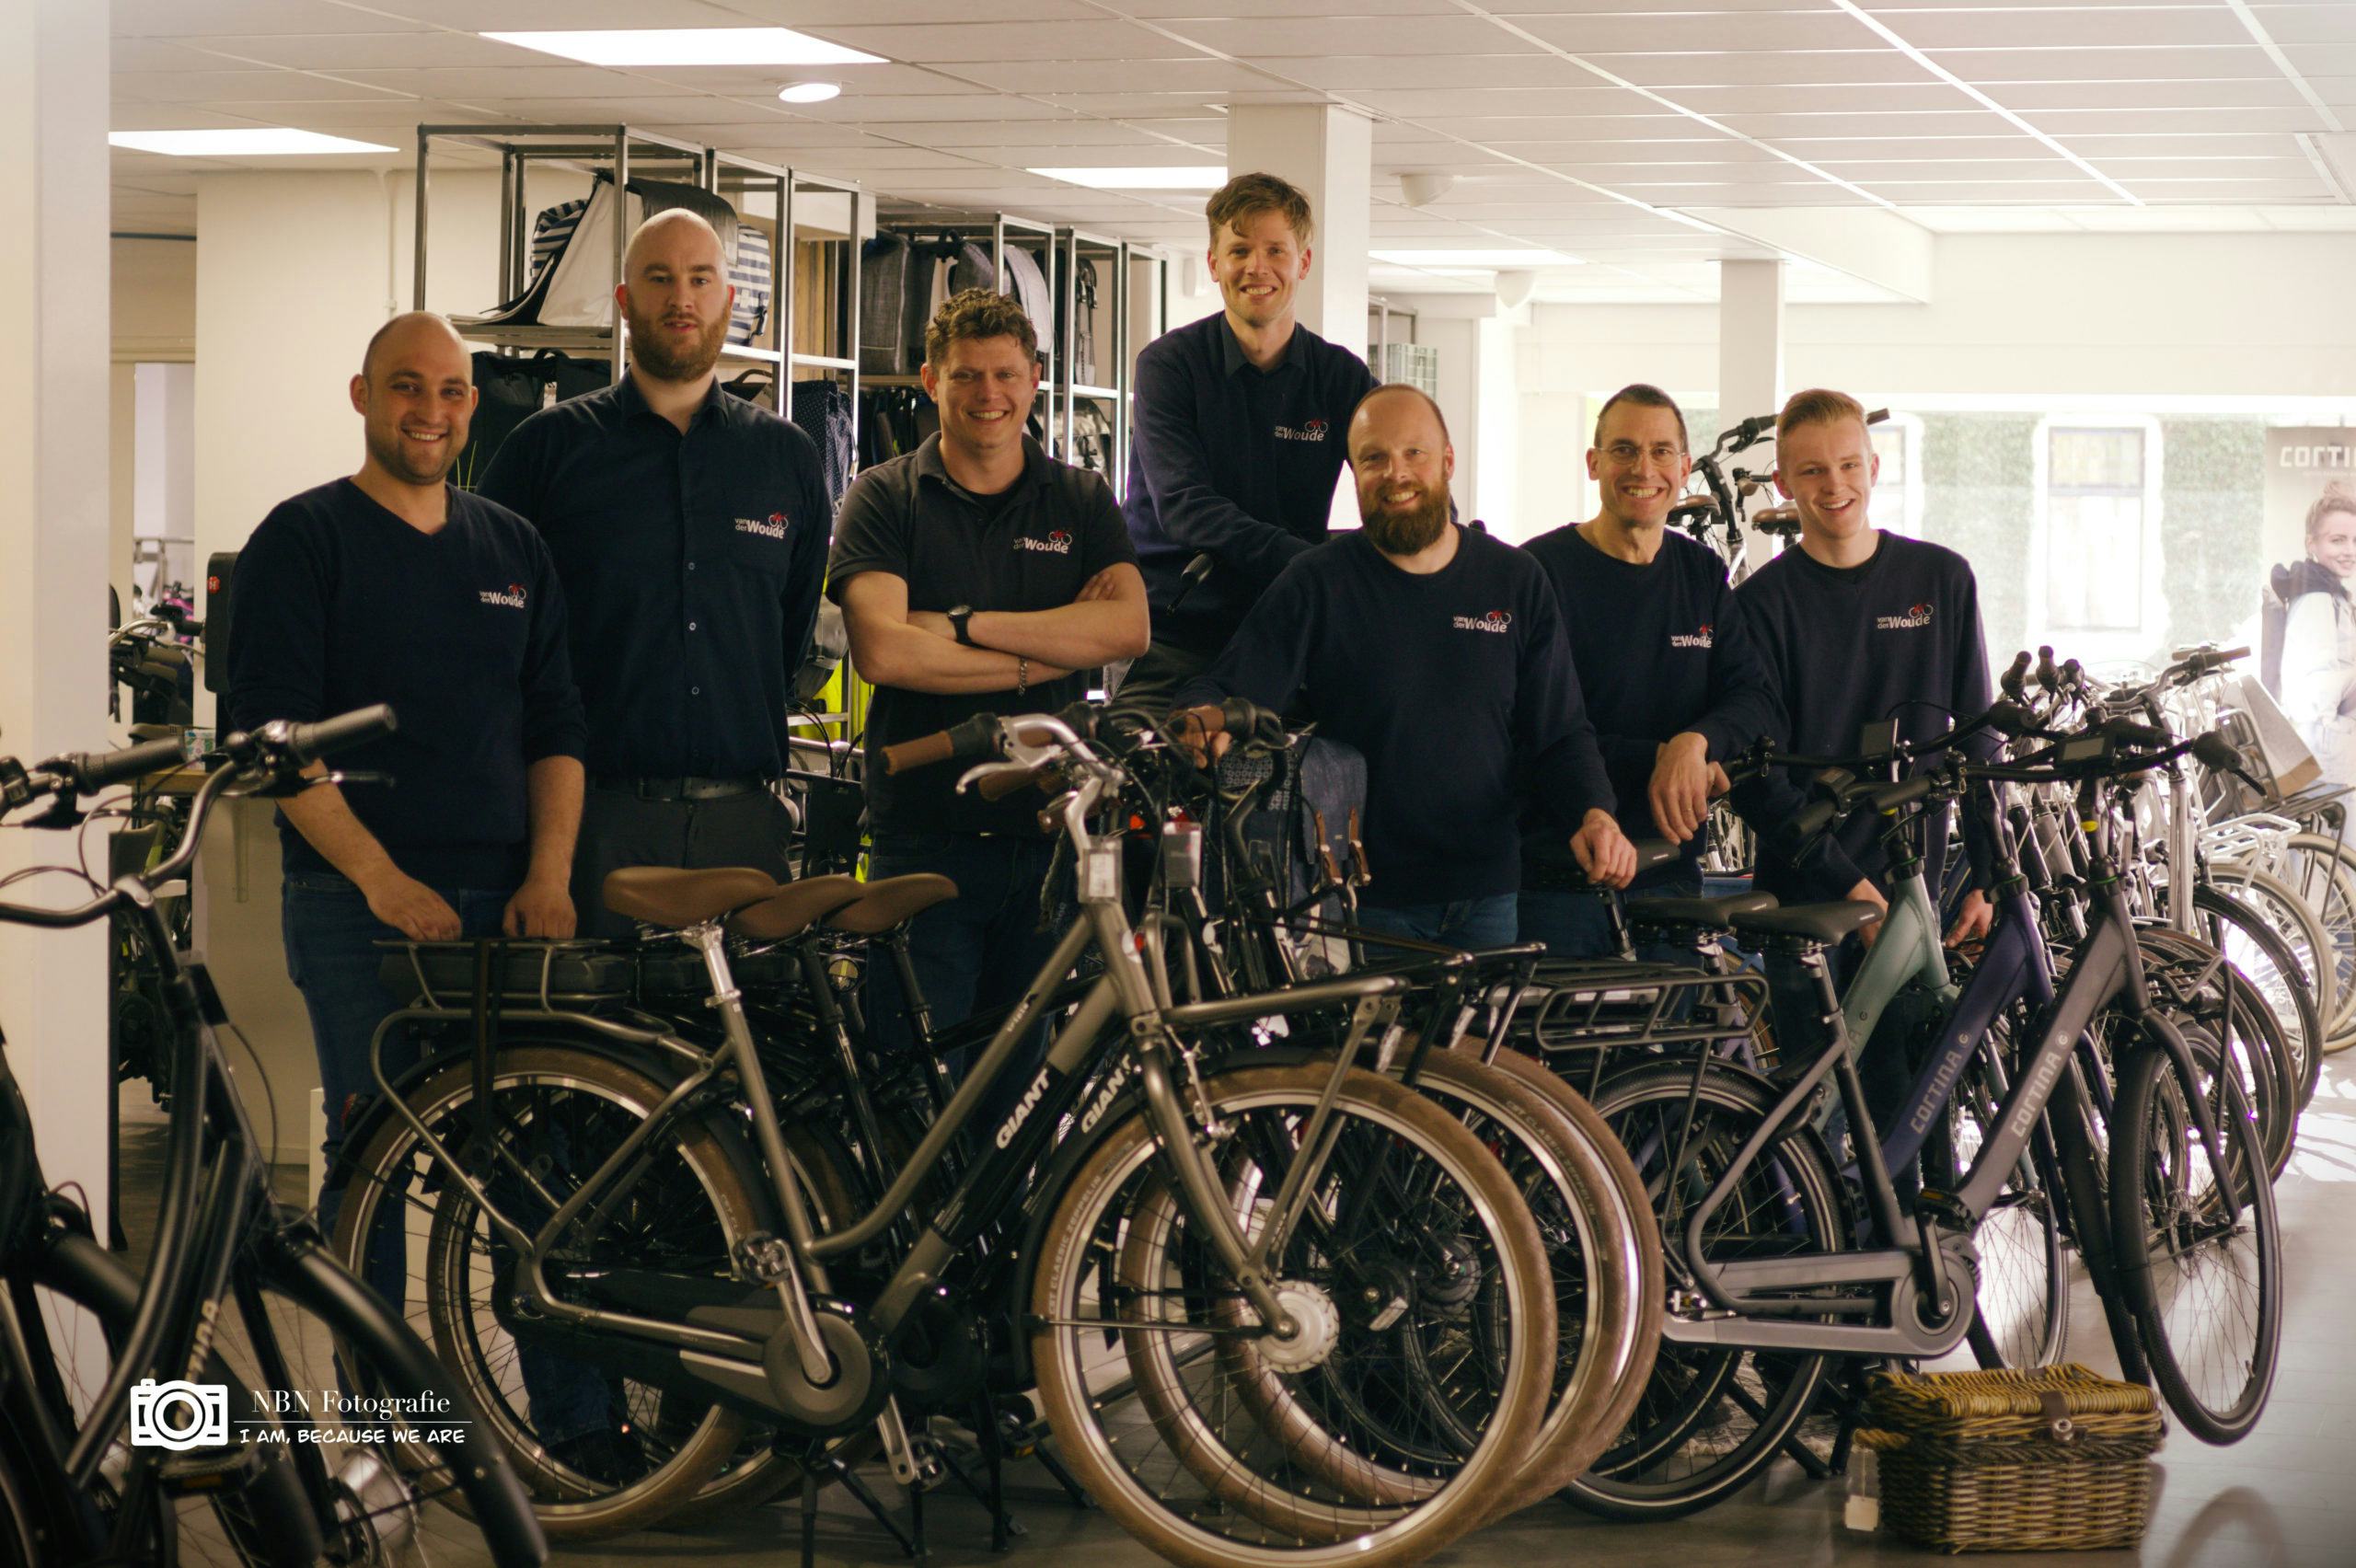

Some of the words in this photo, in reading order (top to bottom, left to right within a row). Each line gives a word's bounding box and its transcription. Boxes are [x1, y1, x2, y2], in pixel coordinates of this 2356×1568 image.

[1284, 428, 1324, 442] Woude
[2280, 446, 2356, 467] CORTI
[746, 520, 784, 539] Woude
[1022, 537, 1068, 554] Woude
[489, 592, 525, 608] Woude
[1463, 617, 1507, 633] Woude
[1888, 614, 1931, 628] Woude
[1910, 1050, 1963, 1134] CORTINA
[2011, 1052, 2062, 1137] CORTINA
[996, 1068, 1050, 1149] GIANT
[1050, 1234, 1069, 1289] CLASSIC
[1066, 1174, 1103, 1234] ZEPPELIN
